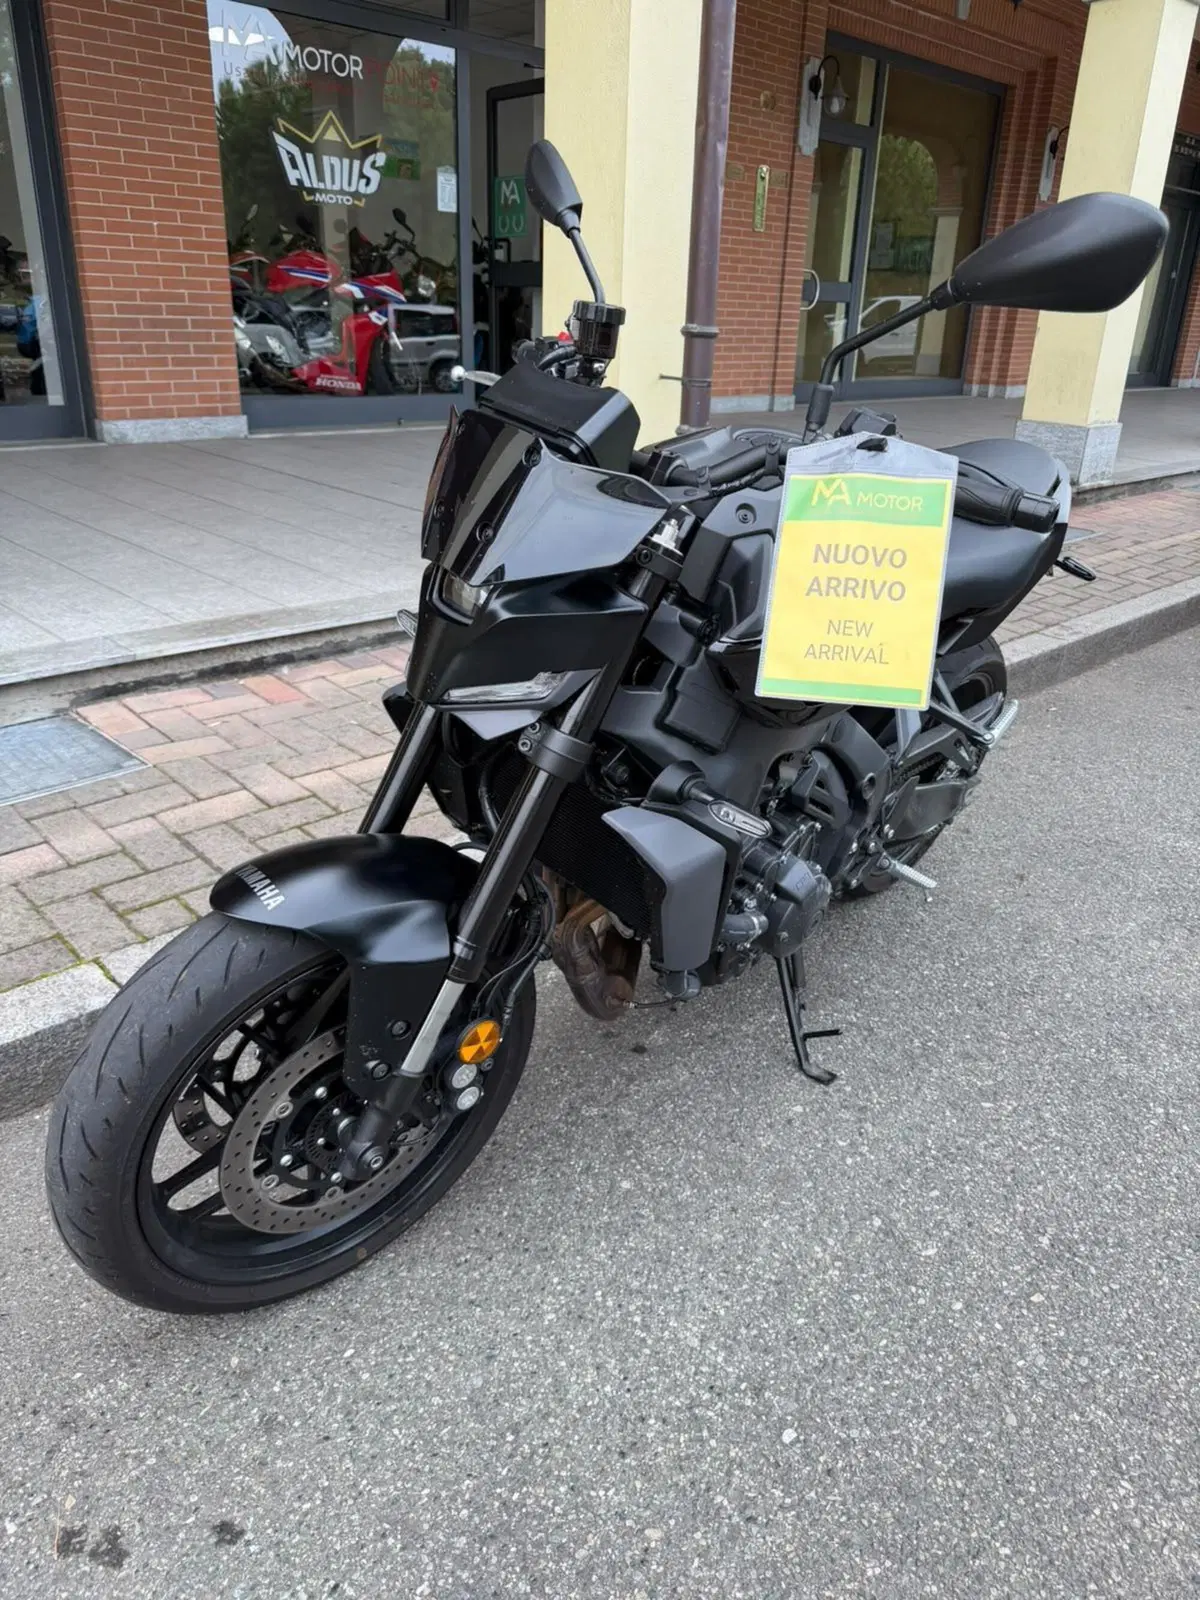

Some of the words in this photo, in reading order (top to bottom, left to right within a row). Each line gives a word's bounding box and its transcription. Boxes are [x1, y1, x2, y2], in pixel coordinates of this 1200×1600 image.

[282, 40, 364, 80] MOTOR
[272, 130, 386, 194] ALDUS
[315, 192, 353, 206] MOTO
[315, 378, 362, 390] HONDA
[857, 492, 923, 511] MOTOR
[813, 543, 908, 569] NUOVO
[805, 575, 906, 602] ARRIVO
[826, 619, 874, 638] NEW
[235, 864, 285, 911] YAMAHA
